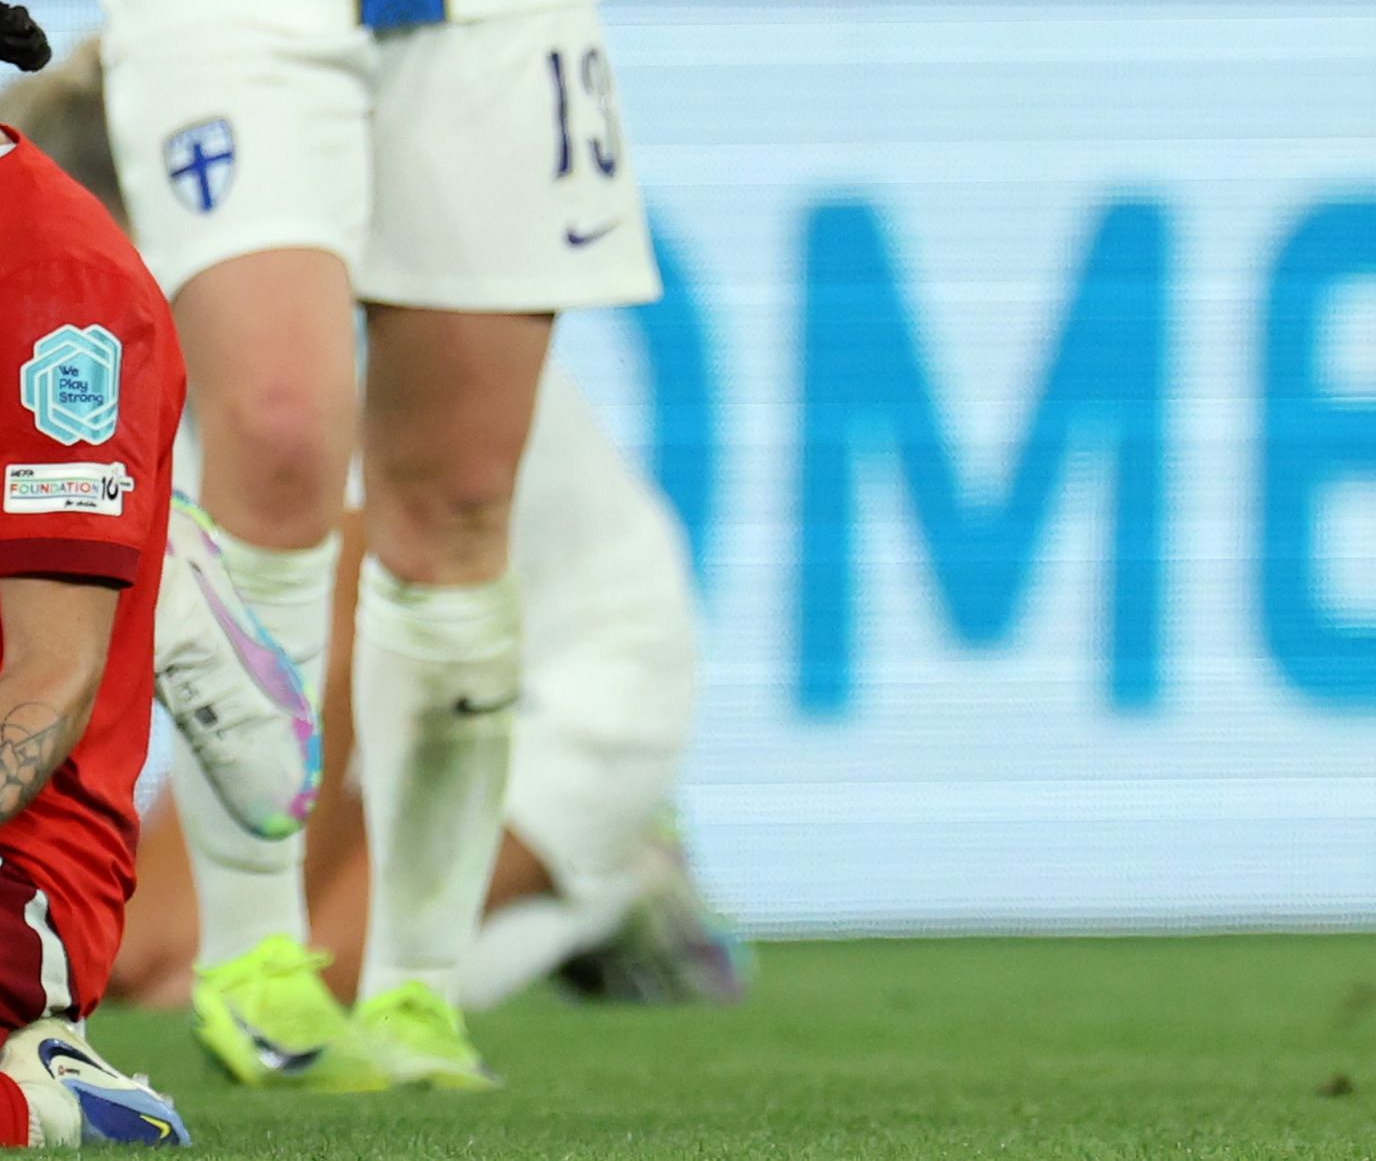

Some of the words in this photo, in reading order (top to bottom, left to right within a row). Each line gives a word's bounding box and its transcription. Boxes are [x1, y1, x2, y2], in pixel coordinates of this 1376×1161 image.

[545, 47, 619, 180] 13
[59, 366, 79, 377] We
[59, 379, 88, 393] Play
[59, 391, 104, 406] Strong
[9, 482, 99, 495] FOUNDATION
